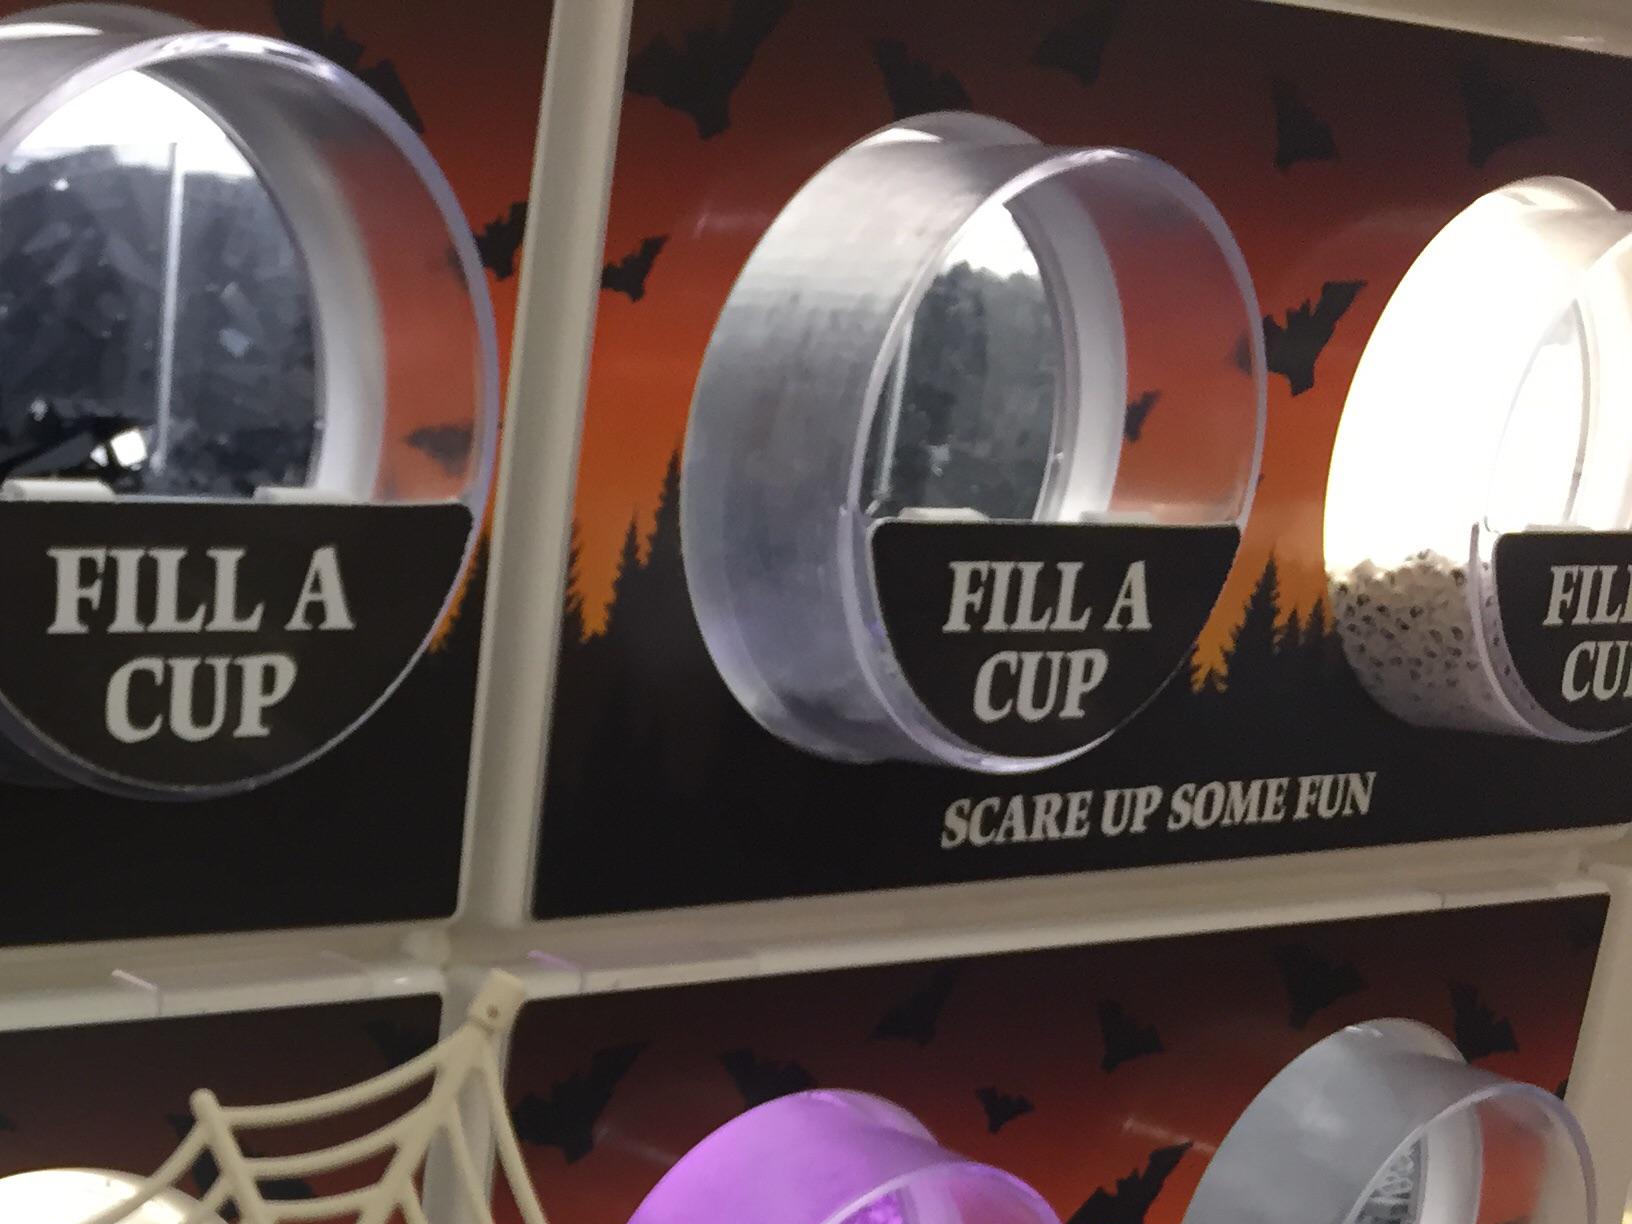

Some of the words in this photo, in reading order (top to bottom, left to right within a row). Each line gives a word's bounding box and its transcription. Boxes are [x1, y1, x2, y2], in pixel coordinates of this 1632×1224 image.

[46, 547, 266, 635] FILL
[284, 544, 356, 632] A
[942, 560, 1092, 633] FILL
[1104, 559, 1153, 632] A
[1543, 564, 1632, 627] FIL
[104, 653, 298, 743] CUP
[972, 648, 1109, 723] CUP
[1561, 640, 1632, 702] CU
[940, 791, 1094, 850] SCARE
[1100, 785, 1164, 835] UP
[1167, 777, 1291, 831] SOME
[1294, 770, 1378, 818] FUN
